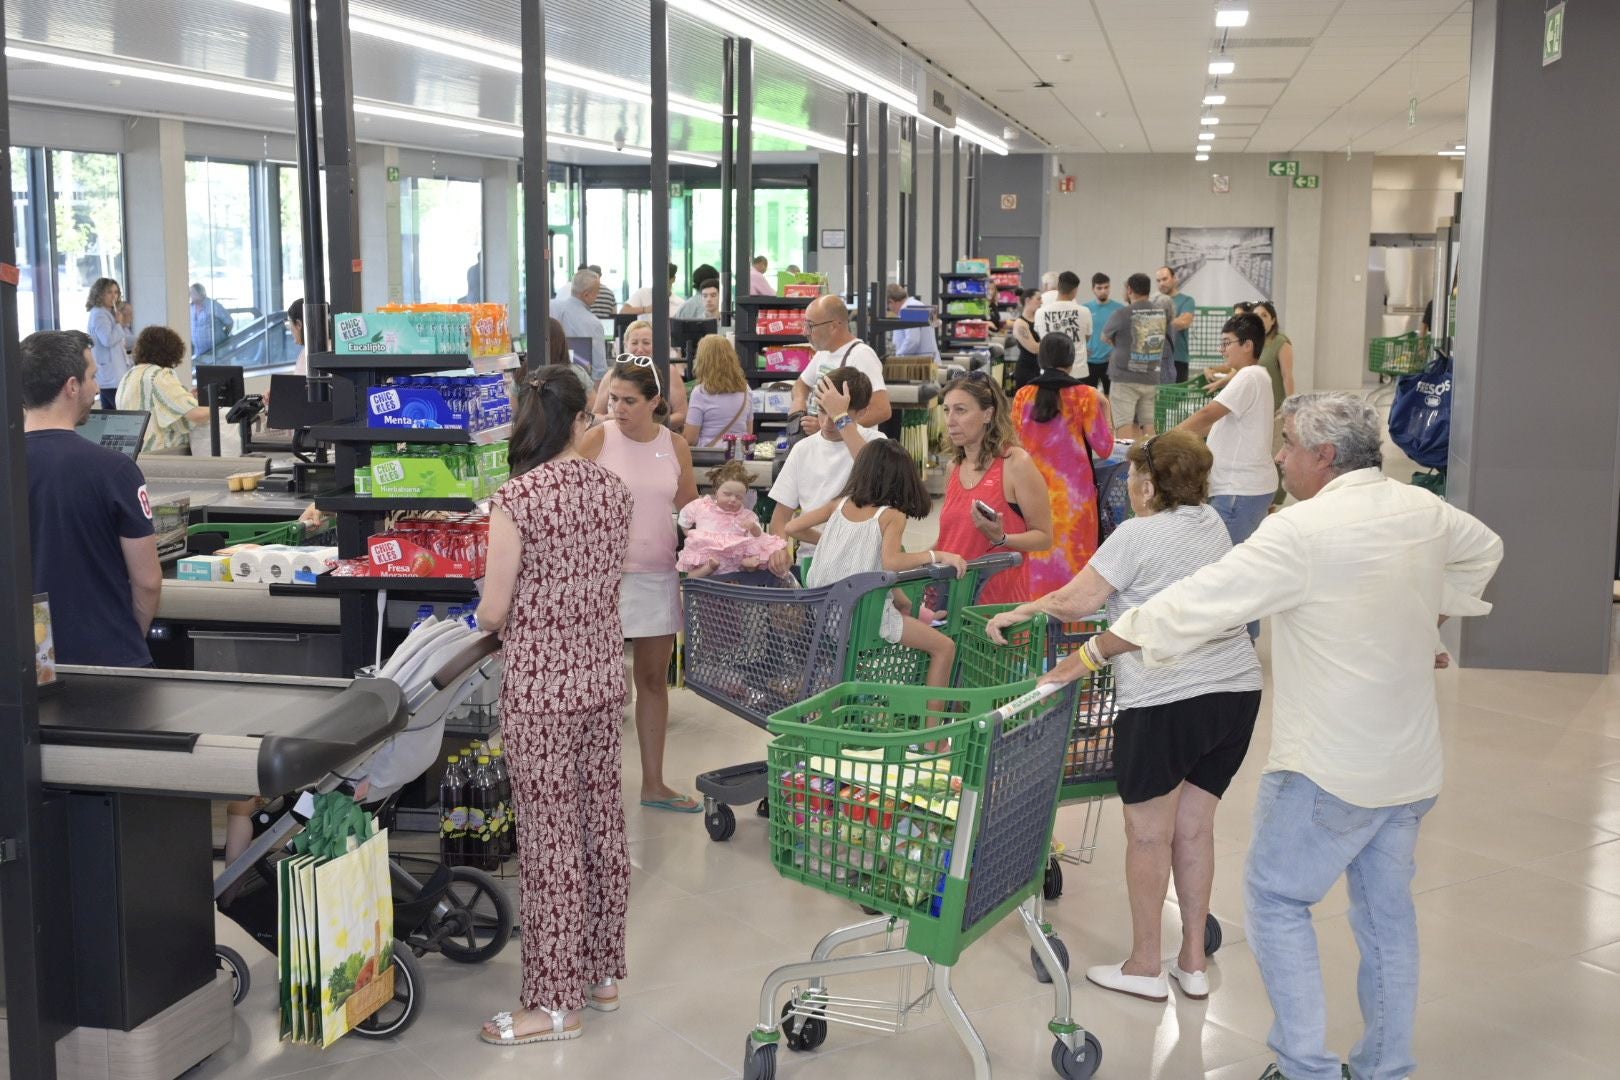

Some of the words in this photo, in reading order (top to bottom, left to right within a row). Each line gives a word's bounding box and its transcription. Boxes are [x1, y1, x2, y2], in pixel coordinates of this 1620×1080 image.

[1044, 310, 1079, 323] NEVER
[342, 326, 363, 339] KLES
[348, 343, 386, 353] Eucalipto
[376, 400, 396, 413] KLES
[384, 415, 412, 425] Menta
[377, 551, 397, 564] KLES
[387, 563, 411, 572] Fresa
